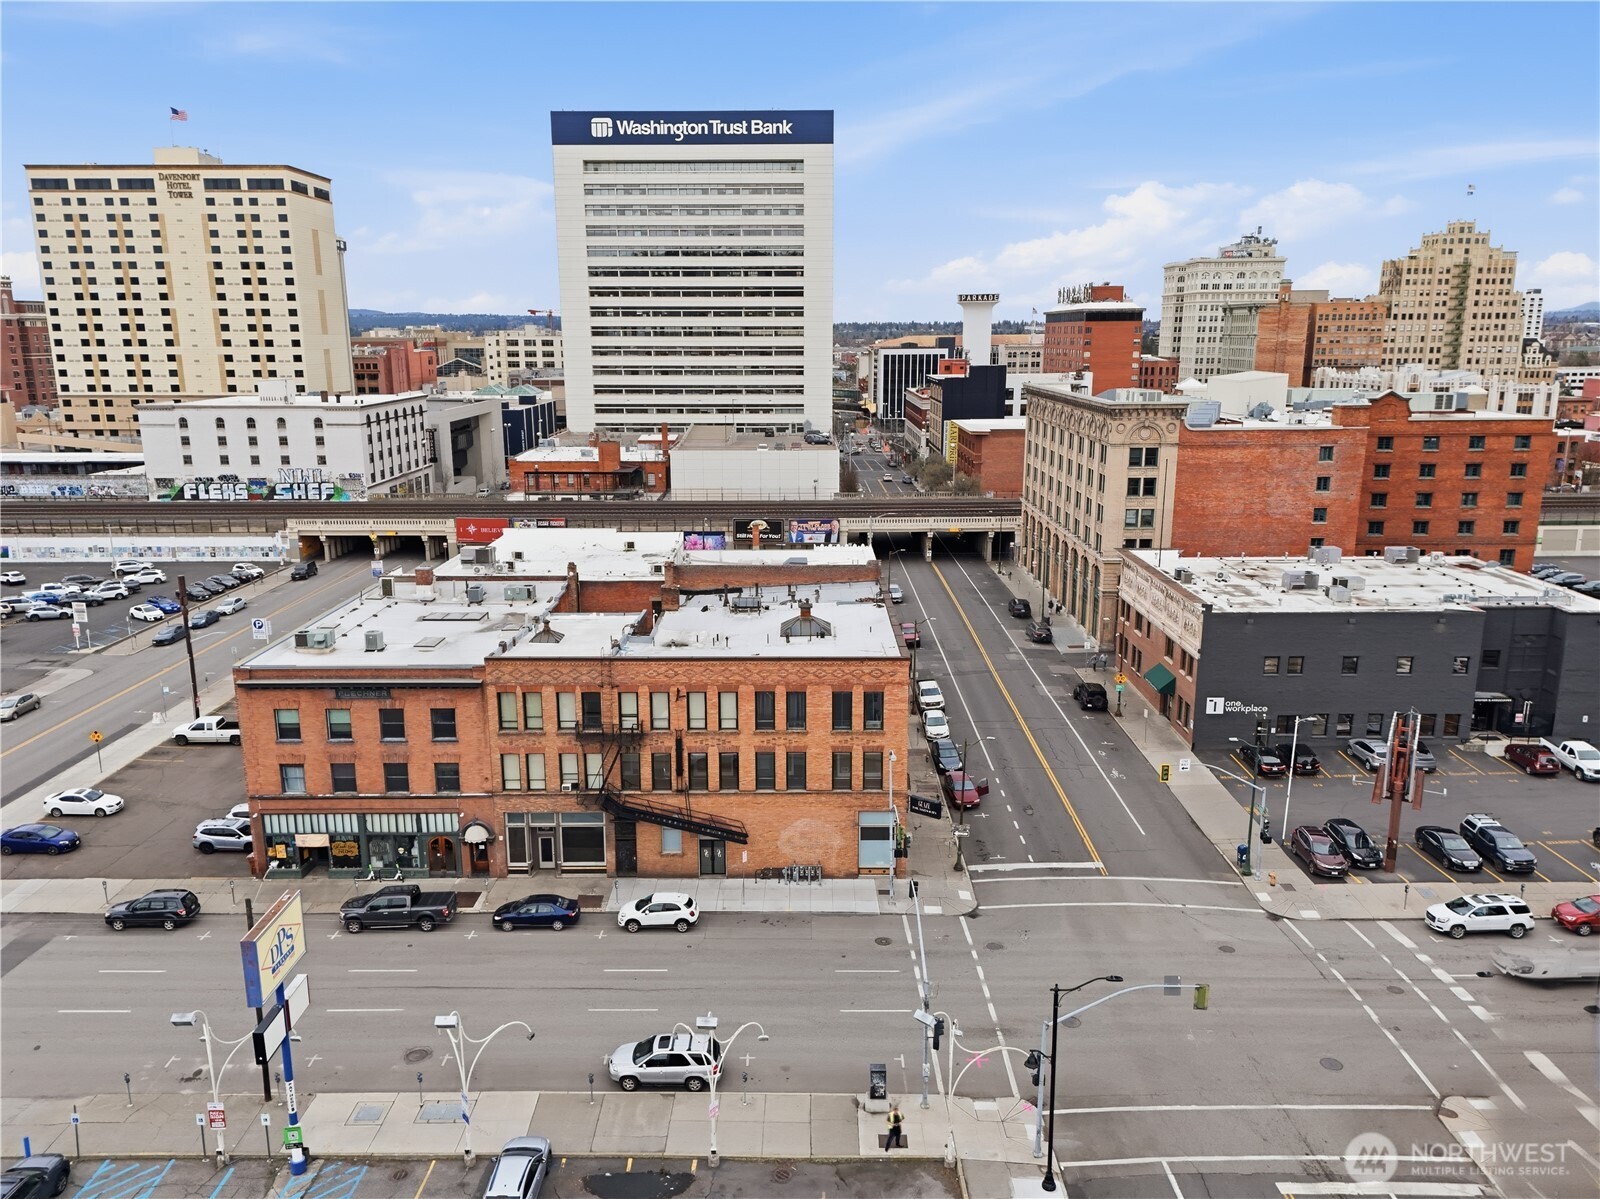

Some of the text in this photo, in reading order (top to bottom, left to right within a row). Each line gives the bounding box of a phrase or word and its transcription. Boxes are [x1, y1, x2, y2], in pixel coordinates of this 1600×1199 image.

[616, 119, 793, 141] Washington Trust Bank
[158, 172, 200, 181] DAVENPORT
[166, 181, 192, 190] HOTEL
[167, 190, 194, 199] TOWER
[1225, 703, 1268, 714] workplace
[270, 926, 294, 965] DPS
